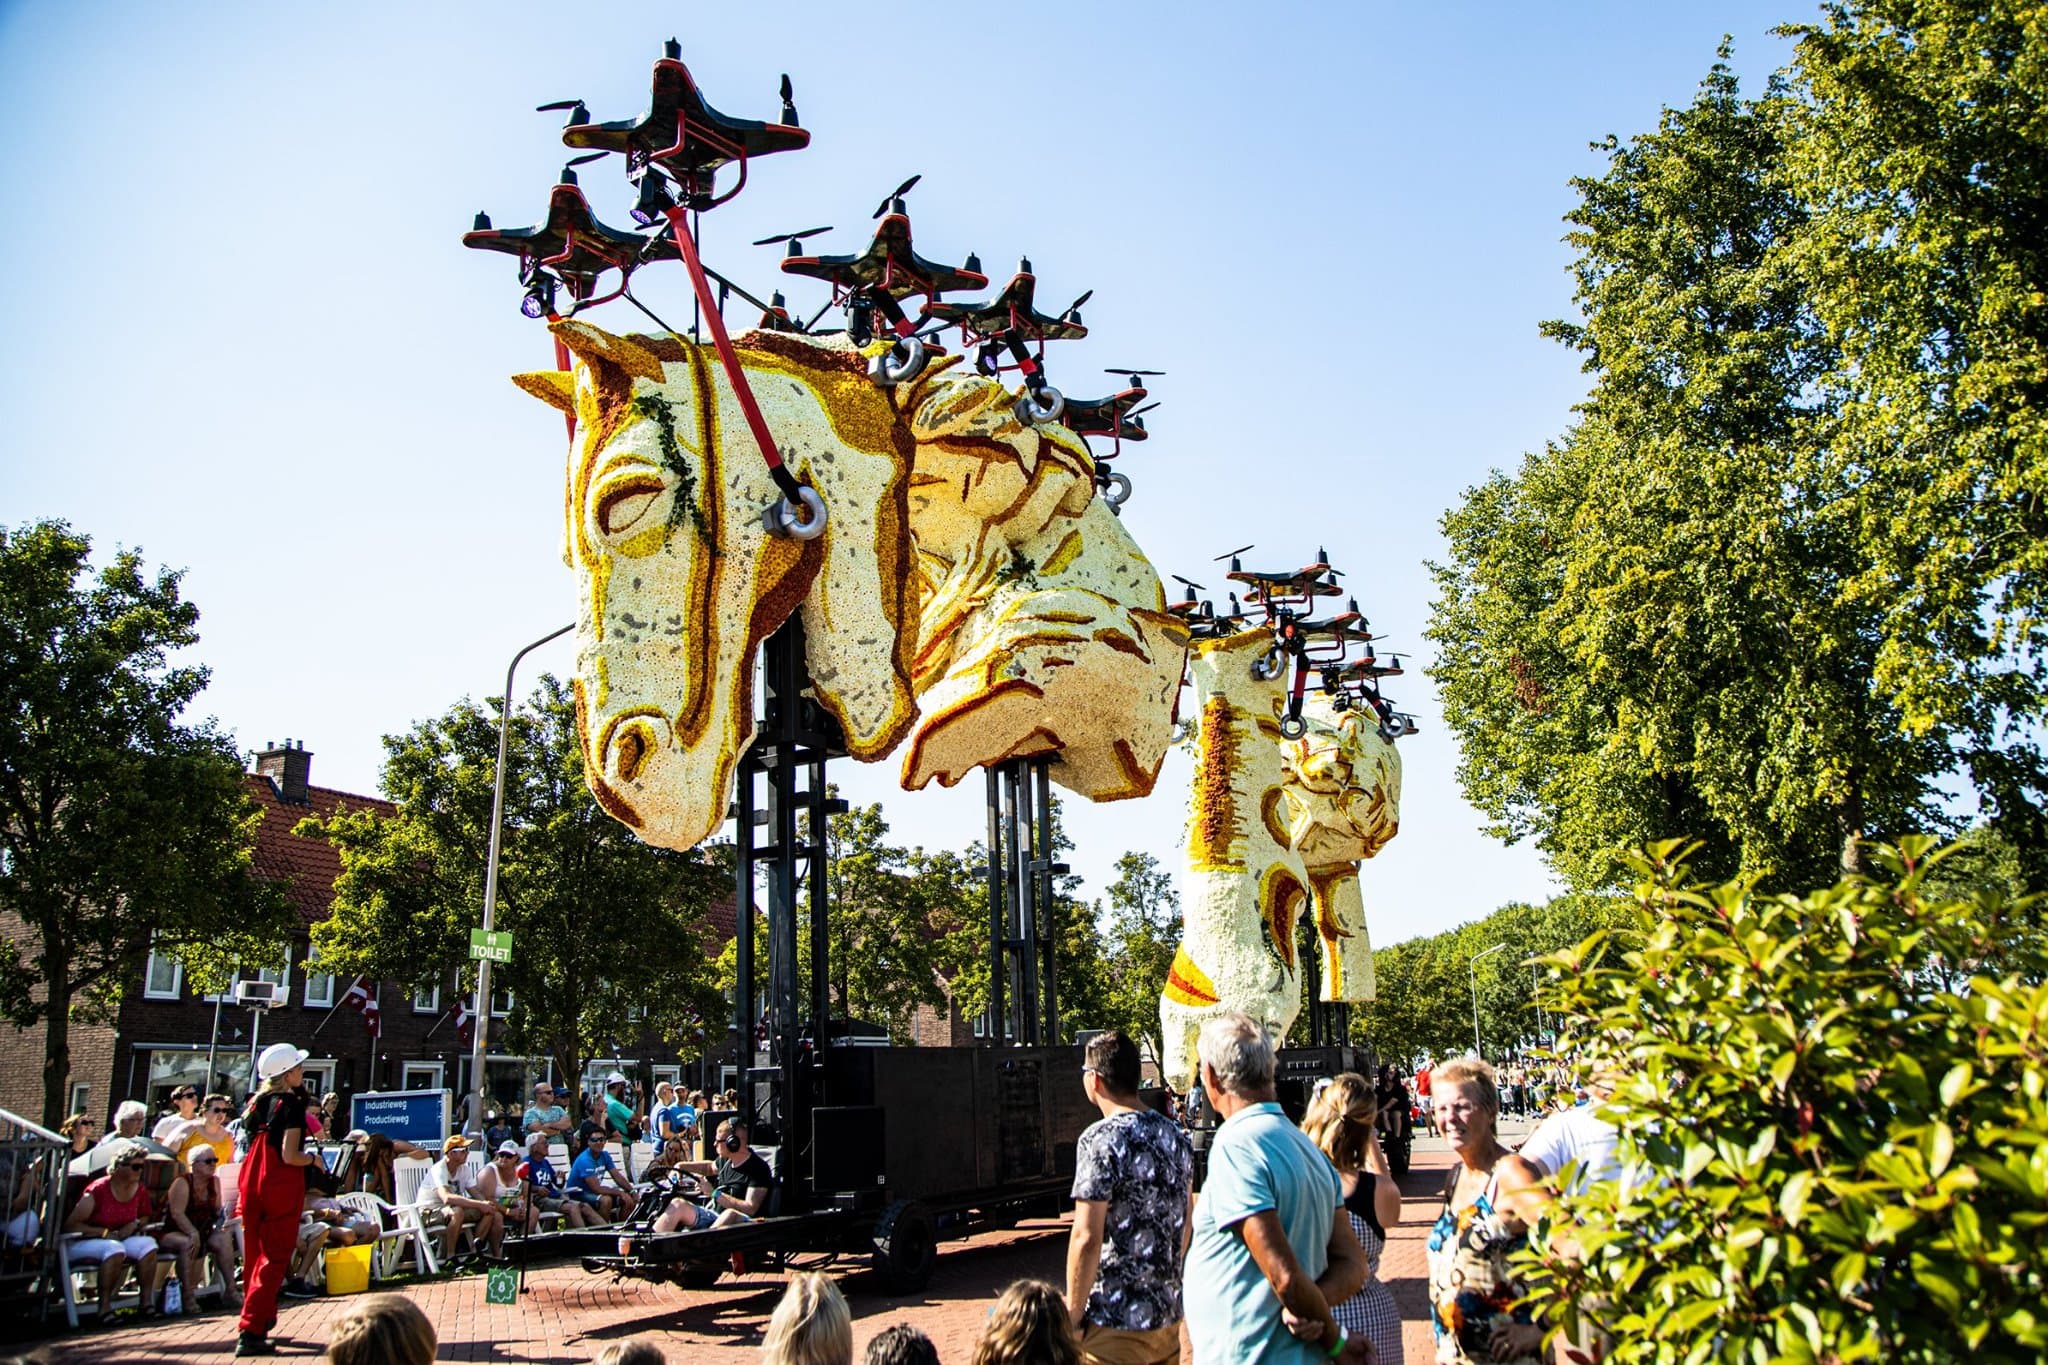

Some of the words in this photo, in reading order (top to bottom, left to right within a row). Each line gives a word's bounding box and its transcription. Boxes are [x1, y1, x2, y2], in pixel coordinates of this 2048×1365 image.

[472, 944, 509, 960] TOILET
[365, 1100, 407, 1110] Industrieweg
[364, 1114, 409, 1125] Productieweg
[498, 1281, 505, 1292] 8
